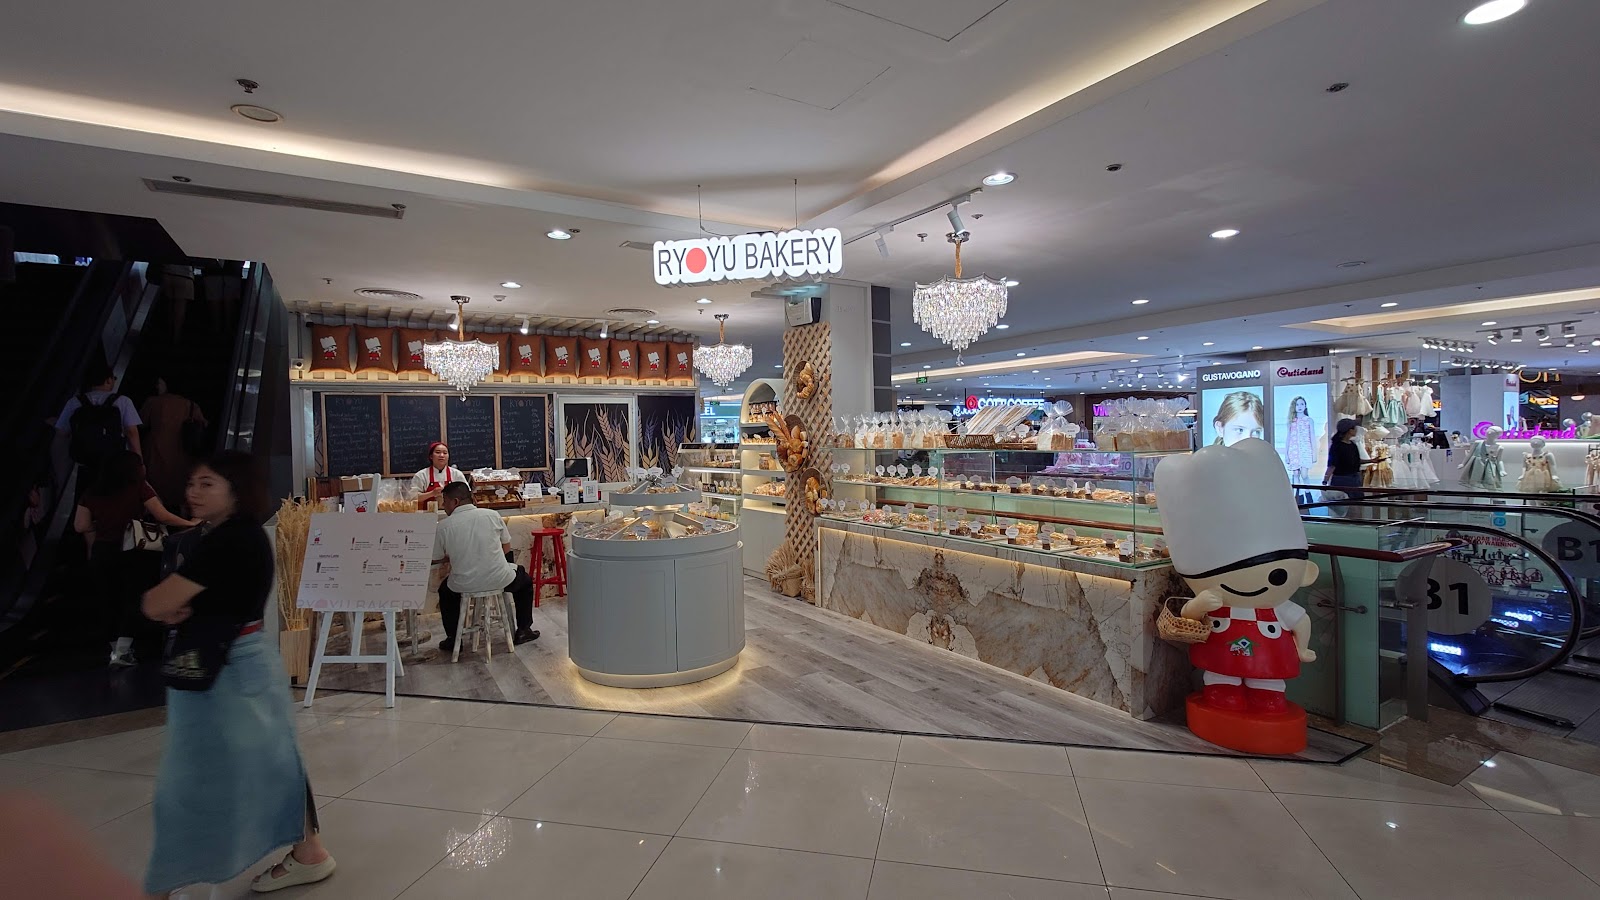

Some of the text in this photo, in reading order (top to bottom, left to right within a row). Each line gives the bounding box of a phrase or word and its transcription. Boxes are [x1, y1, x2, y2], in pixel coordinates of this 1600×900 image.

[745, 236, 836, 269] BAKERY
[1202, 369, 1260, 381] GUSTAVOGANO
[1558, 536, 1600, 563] B1
